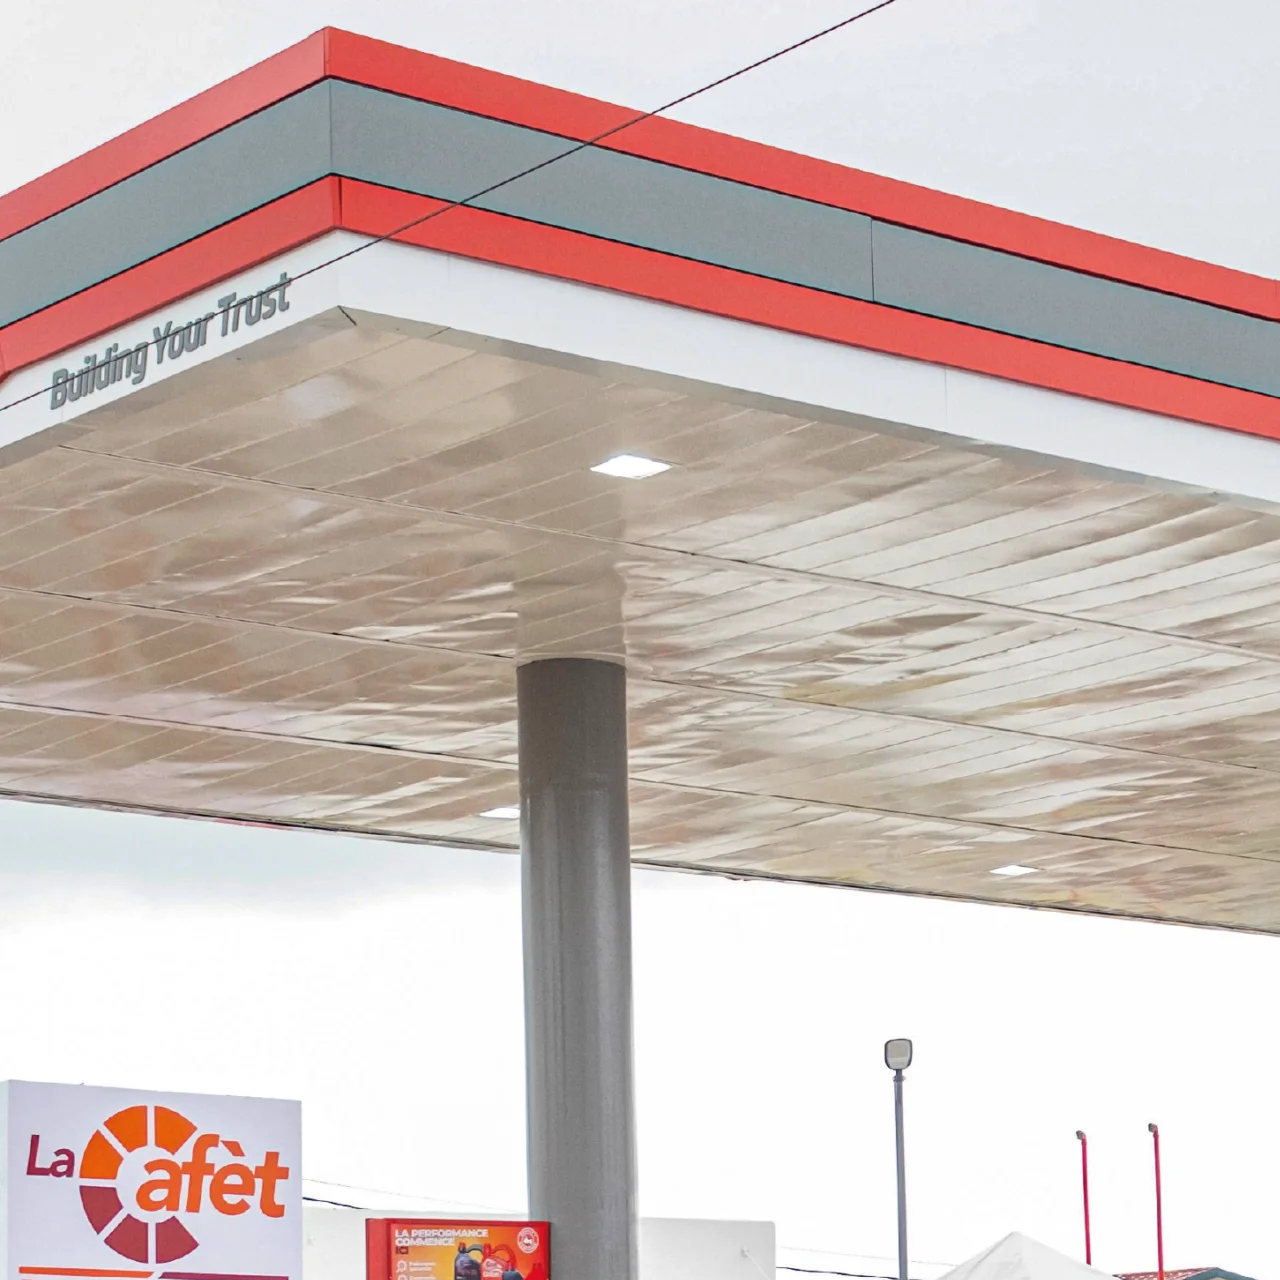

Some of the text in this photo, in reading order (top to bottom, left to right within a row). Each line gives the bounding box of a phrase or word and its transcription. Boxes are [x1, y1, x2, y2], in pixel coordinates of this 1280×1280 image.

[50, 272, 292, 410] Building Your Trust
[26, 1134, 75, 1178] La
[412, 1229, 488, 1238] PERFORMANCE
